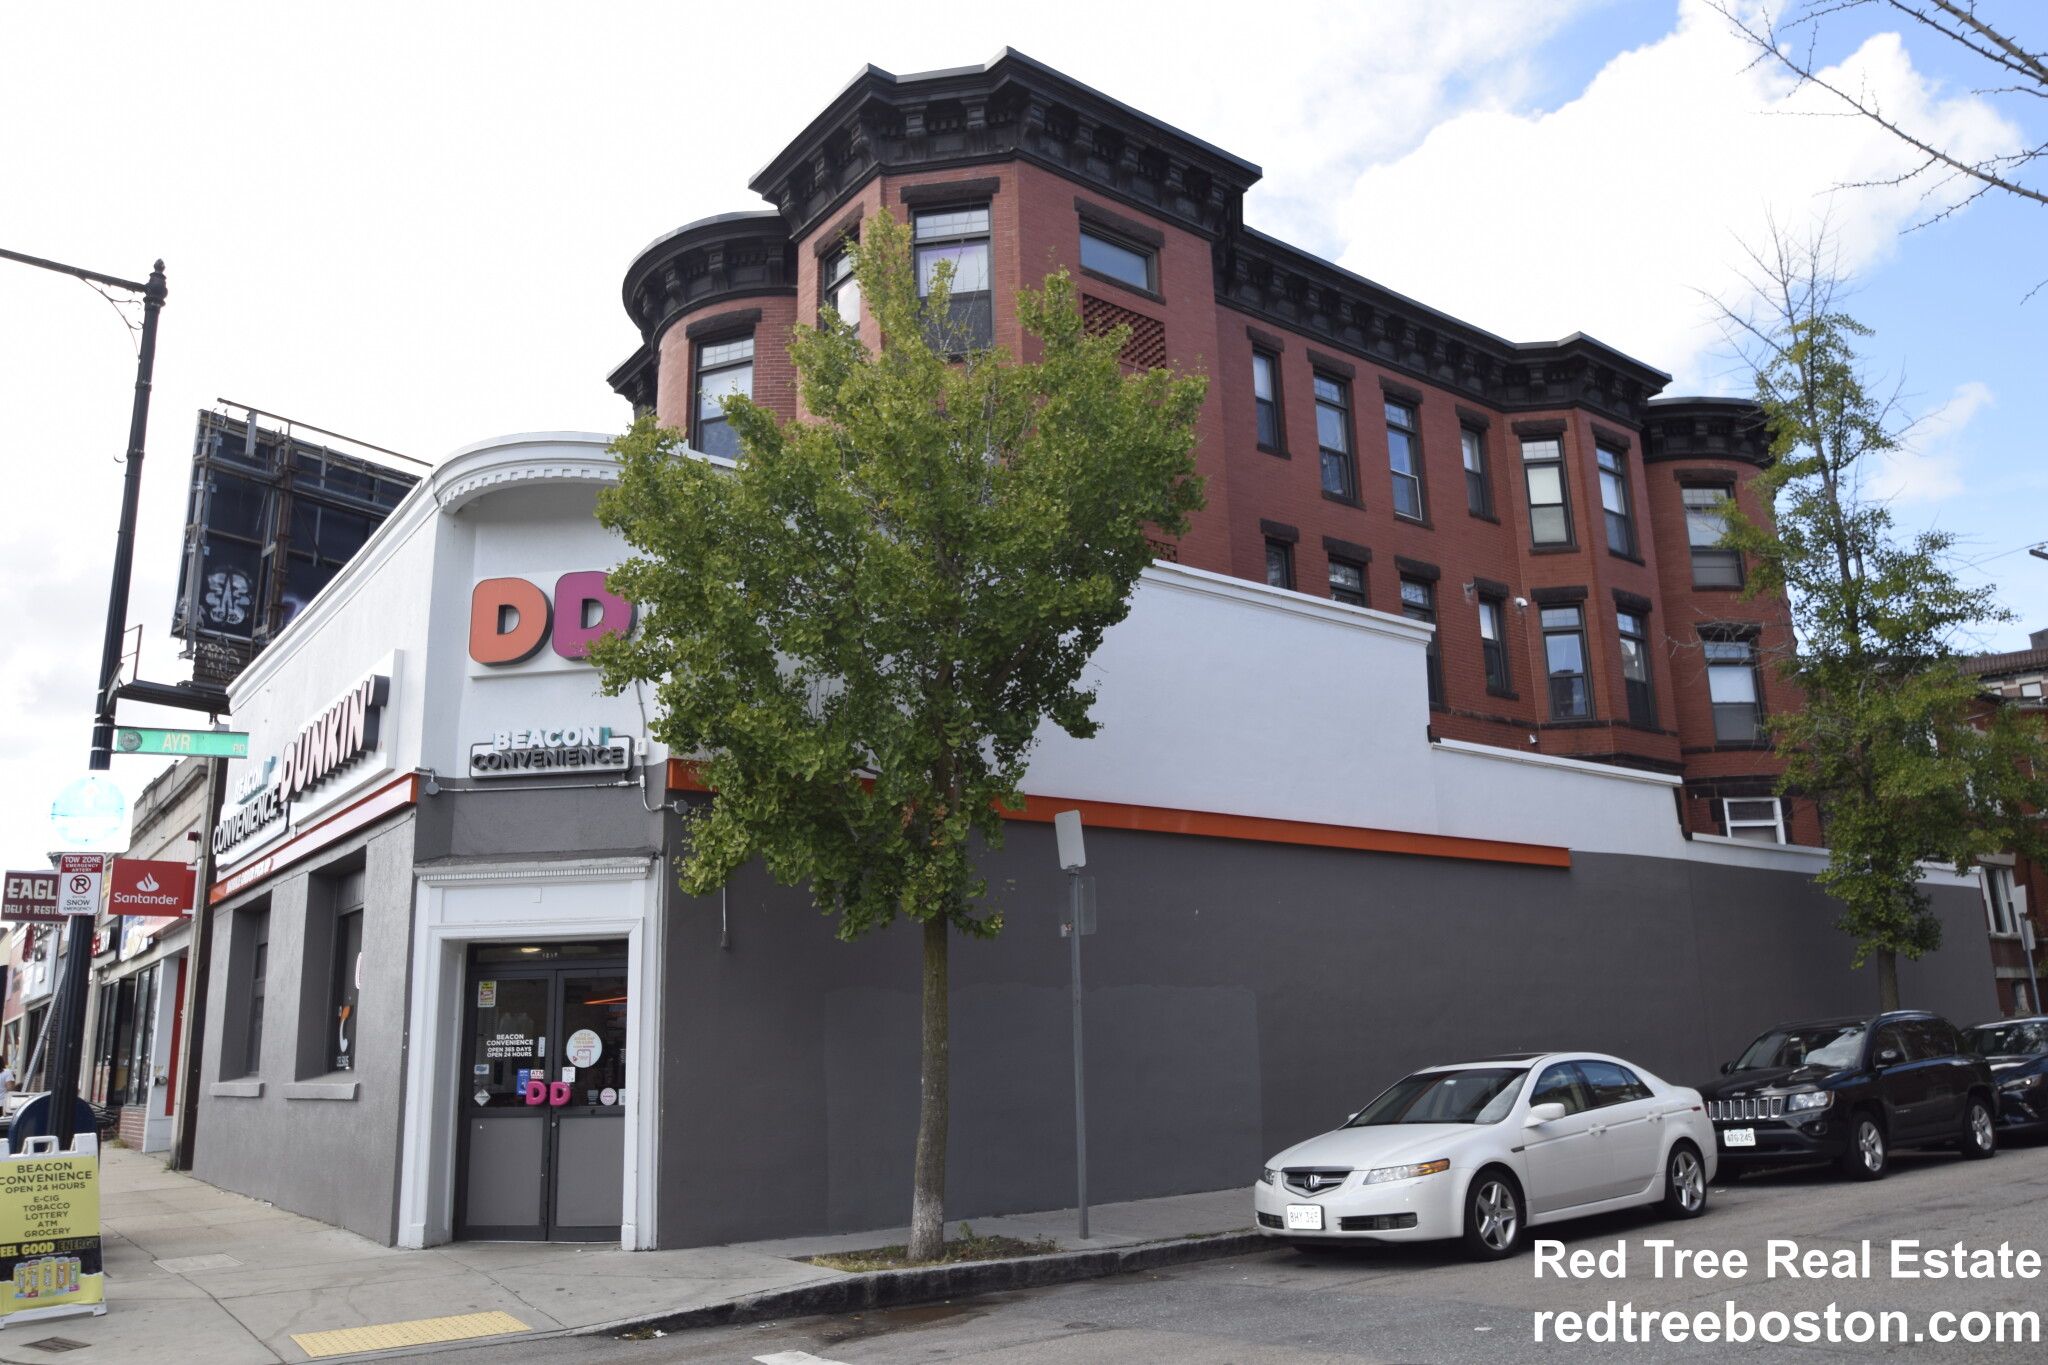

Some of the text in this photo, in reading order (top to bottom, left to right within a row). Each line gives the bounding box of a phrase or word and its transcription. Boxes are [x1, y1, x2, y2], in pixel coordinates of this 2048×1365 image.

[469, 571, 638, 666] DD
[162, 732, 246, 754] AYR RD
[280, 673, 390, 803] DUNKIN'
[495, 726, 606, 751] BEACON
[472, 747, 625, 770] CONVENIENCE
[235, 762, 266, 802] BEACON
[212, 786, 278, 855] CONVENIENCE
[65, 856, 101, 864] TOW ZONE
[7, 878, 58, 900] EAGL
[114, 892, 179, 905] Santander
[4, 904, 23, 914] DELI
[33, 905, 58, 915] REST
[17, 1162, 72, 1174] BEACON
[0, 1170, 92, 1185] CONVENIENCE
[5, 1182, 86, 1194] OPEN 24 HOURS
[34, 1195, 60, 1203] E-CIG
[23, 1202, 71, 1212] TOBACCO
[25, 1211, 69, 1221] LOTTERY
[38, 1220, 58, 1228] ATM
[24, 1227, 71, 1238] GROCERY
[0, 1245, 18, 1258] EEL
[21, 1241, 55, 1255] GOOD
[58, 1238, 98, 1252] ENERGY
